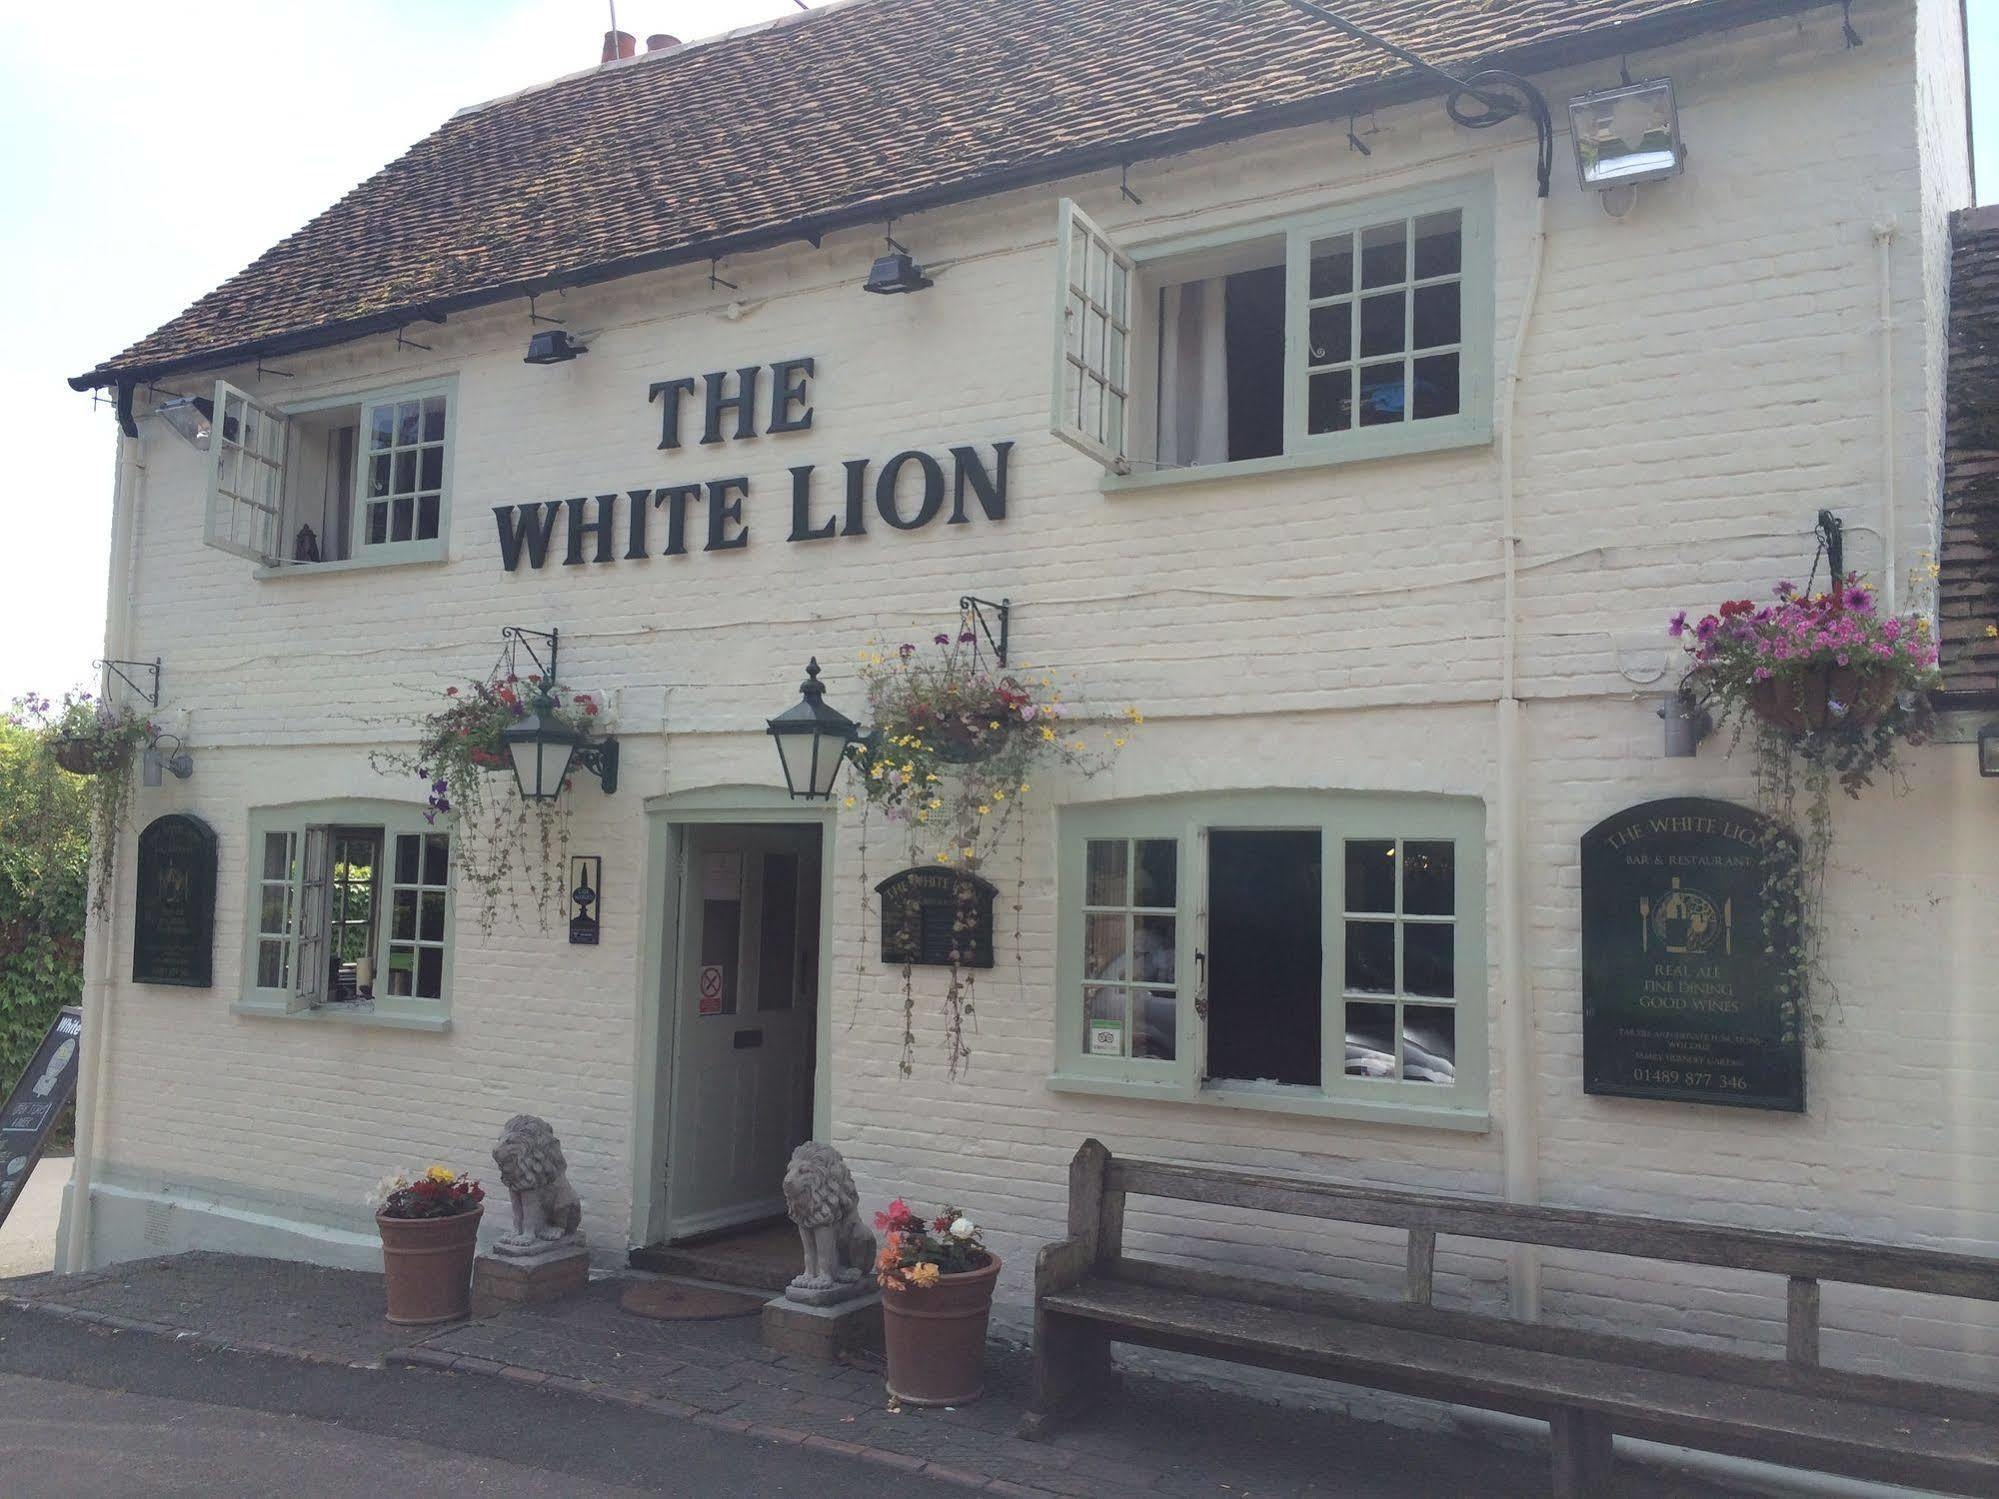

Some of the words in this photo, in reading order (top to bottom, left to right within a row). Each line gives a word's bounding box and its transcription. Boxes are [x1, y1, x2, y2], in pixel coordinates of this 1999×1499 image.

[649, 357, 815, 450] THE
[492, 477, 748, 572] WHITE
[787, 441, 1015, 542] LION
[1608, 823, 1643, 849] THE
[1649, 816, 1718, 833] WHITE
[1722, 821, 1760, 850] LIO
[1626, 855, 1649, 865] BAR
[1654, 855, 1664, 865] &
[1655, 964, 1688, 976] REAL
[1696, 966, 1721, 978] ALE
[1644, 979, 1674, 992] FINE
[1679, 981, 1734, 996] DINING
[1639, 995, 1687, 1008] GOOD
[1691, 998, 1739, 1013] WINES
[1633, 1068, 1679, 1084] 01489
[1685, 1072, 1712, 1086] 877
[1719, 1074, 1747, 1089] 346
